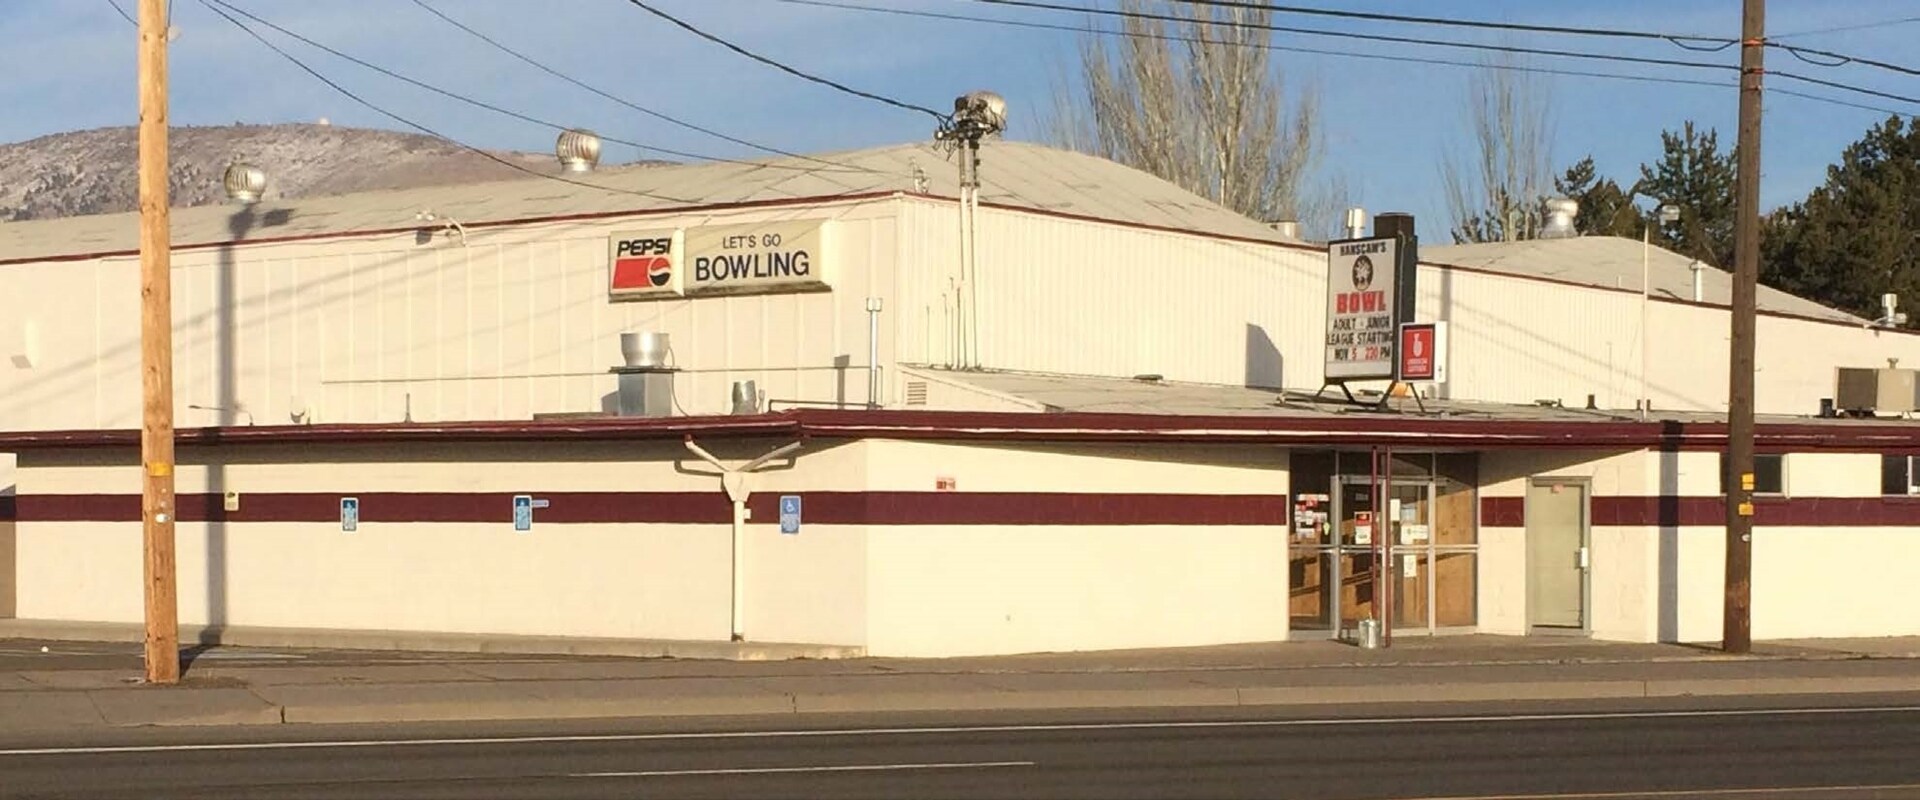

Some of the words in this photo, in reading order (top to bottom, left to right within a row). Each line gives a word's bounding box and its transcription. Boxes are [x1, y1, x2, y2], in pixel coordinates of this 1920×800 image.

[617, 237, 673, 257] PEPSI
[722, 235, 757, 249] LET'S
[762, 233, 782, 248] GO
[695, 251, 810, 281] BOWLING
[1337, 291, 1386, 314] BOWL
[1334, 318, 1356, 330] ADULT
[1366, 315, 1390, 330] JUNIOR
[1327, 331, 1354, 346] LEAGUE
[1357, 330, 1393, 345] STARTING
[1380, 345, 1391, 359] PM
